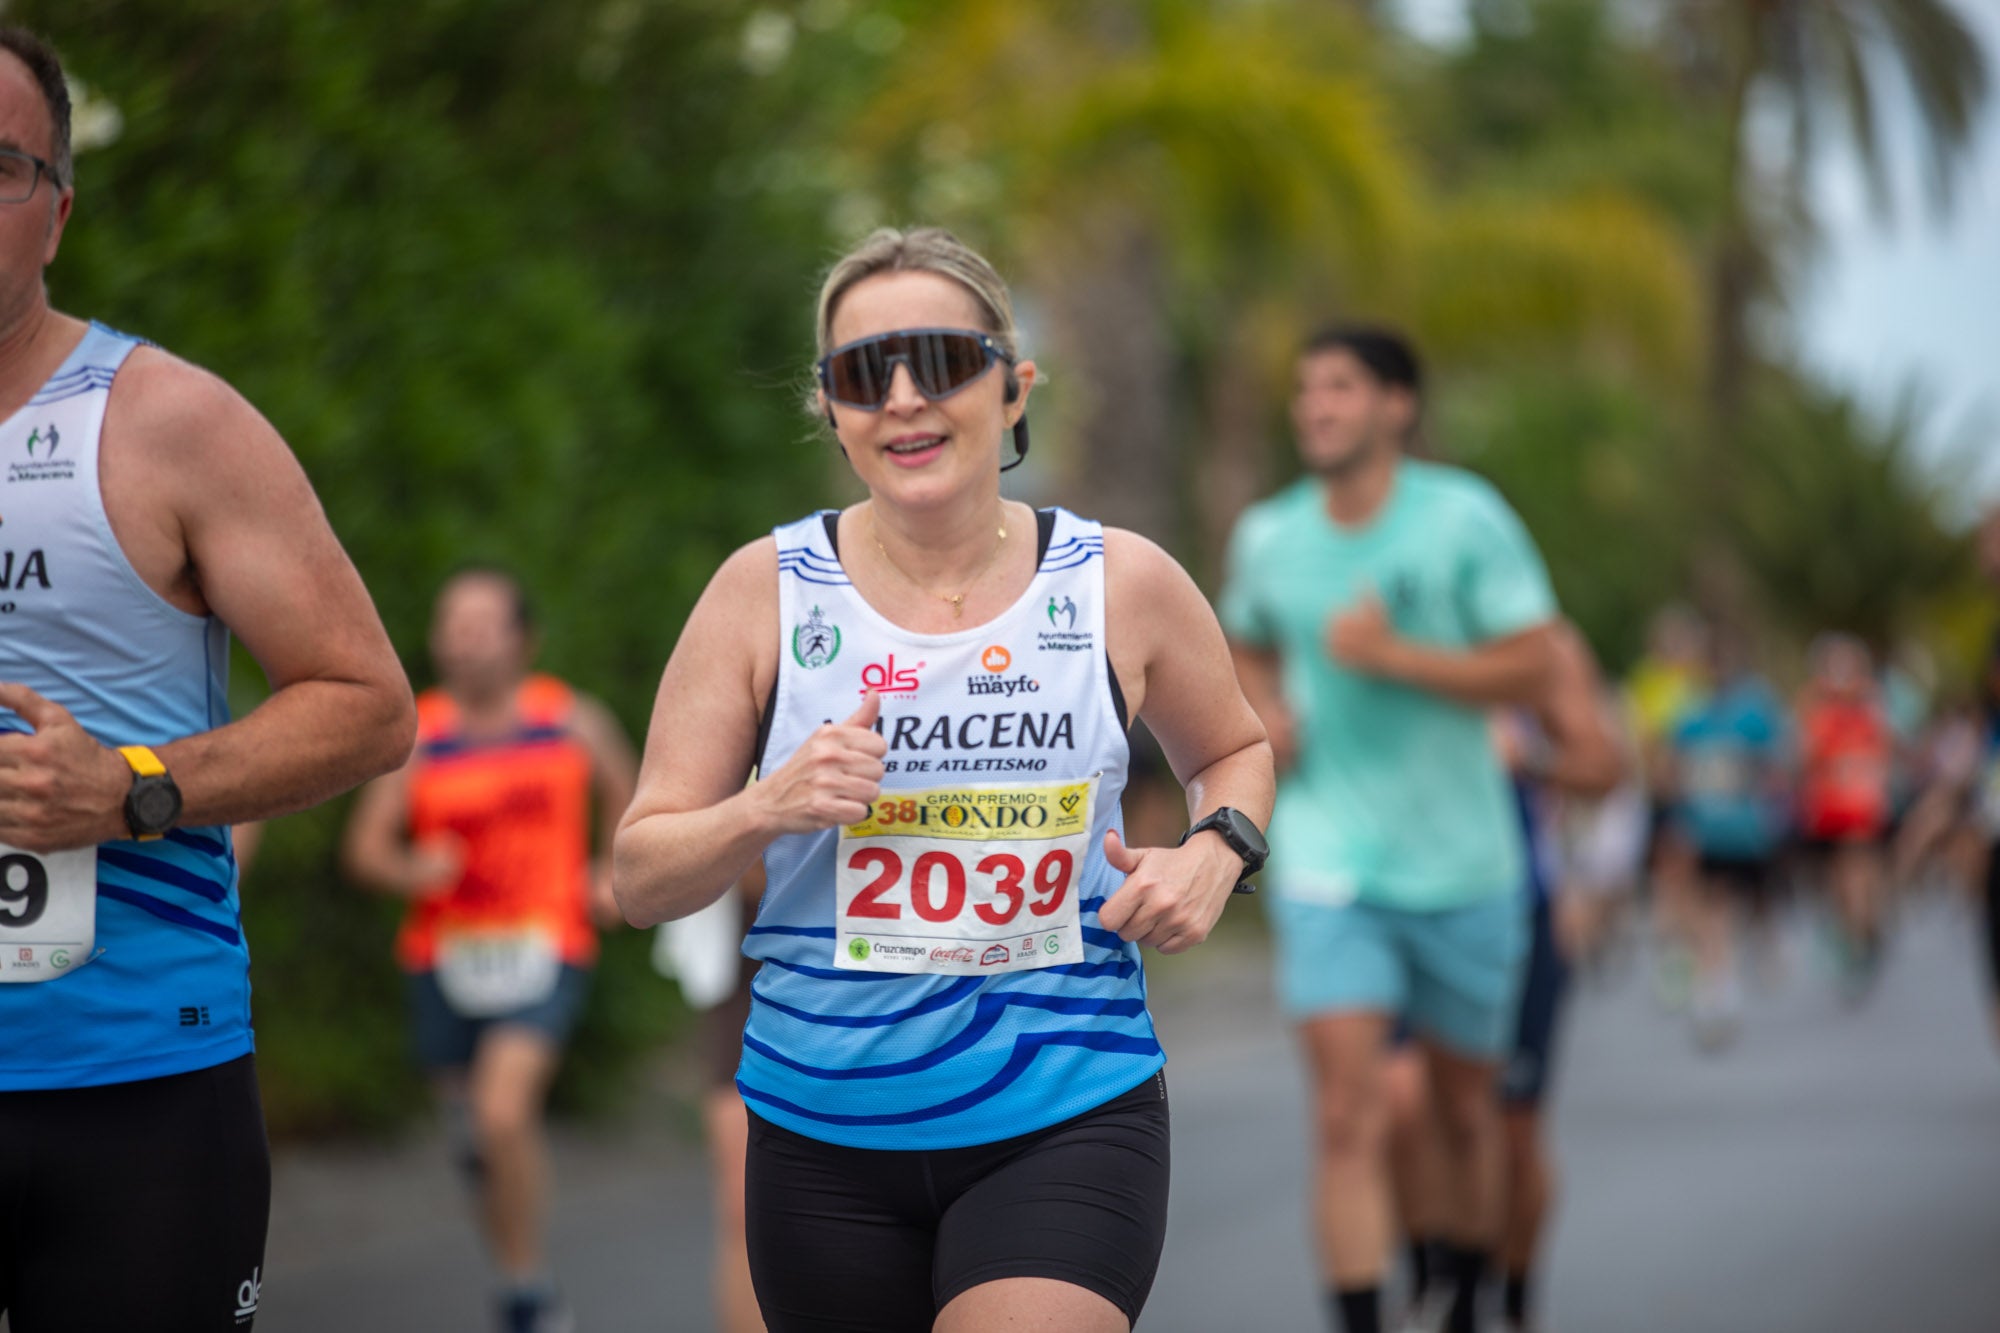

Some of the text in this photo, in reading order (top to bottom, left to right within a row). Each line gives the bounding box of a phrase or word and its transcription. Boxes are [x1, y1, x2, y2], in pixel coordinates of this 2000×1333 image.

[18, 471, 75, 482] Maracena
[1038, 631, 1093, 642] Ayuntamiento
[1047, 641, 1093, 652] Maracena
[967, 675, 1040, 698] mayfo
[822, 712, 1075, 750] RACENA
[906, 759, 932, 773] DE
[936, 758, 1048, 773] ATLETISMO
[926, 794, 973, 805] GRAN
[977, 793, 1037, 805] PREMIO
[876, 799, 918, 826] 38
[918, 804, 1048, 829] FONDO
[846, 847, 1073, 926] 2039
[873, 942, 926, 957] Cruzcampo
